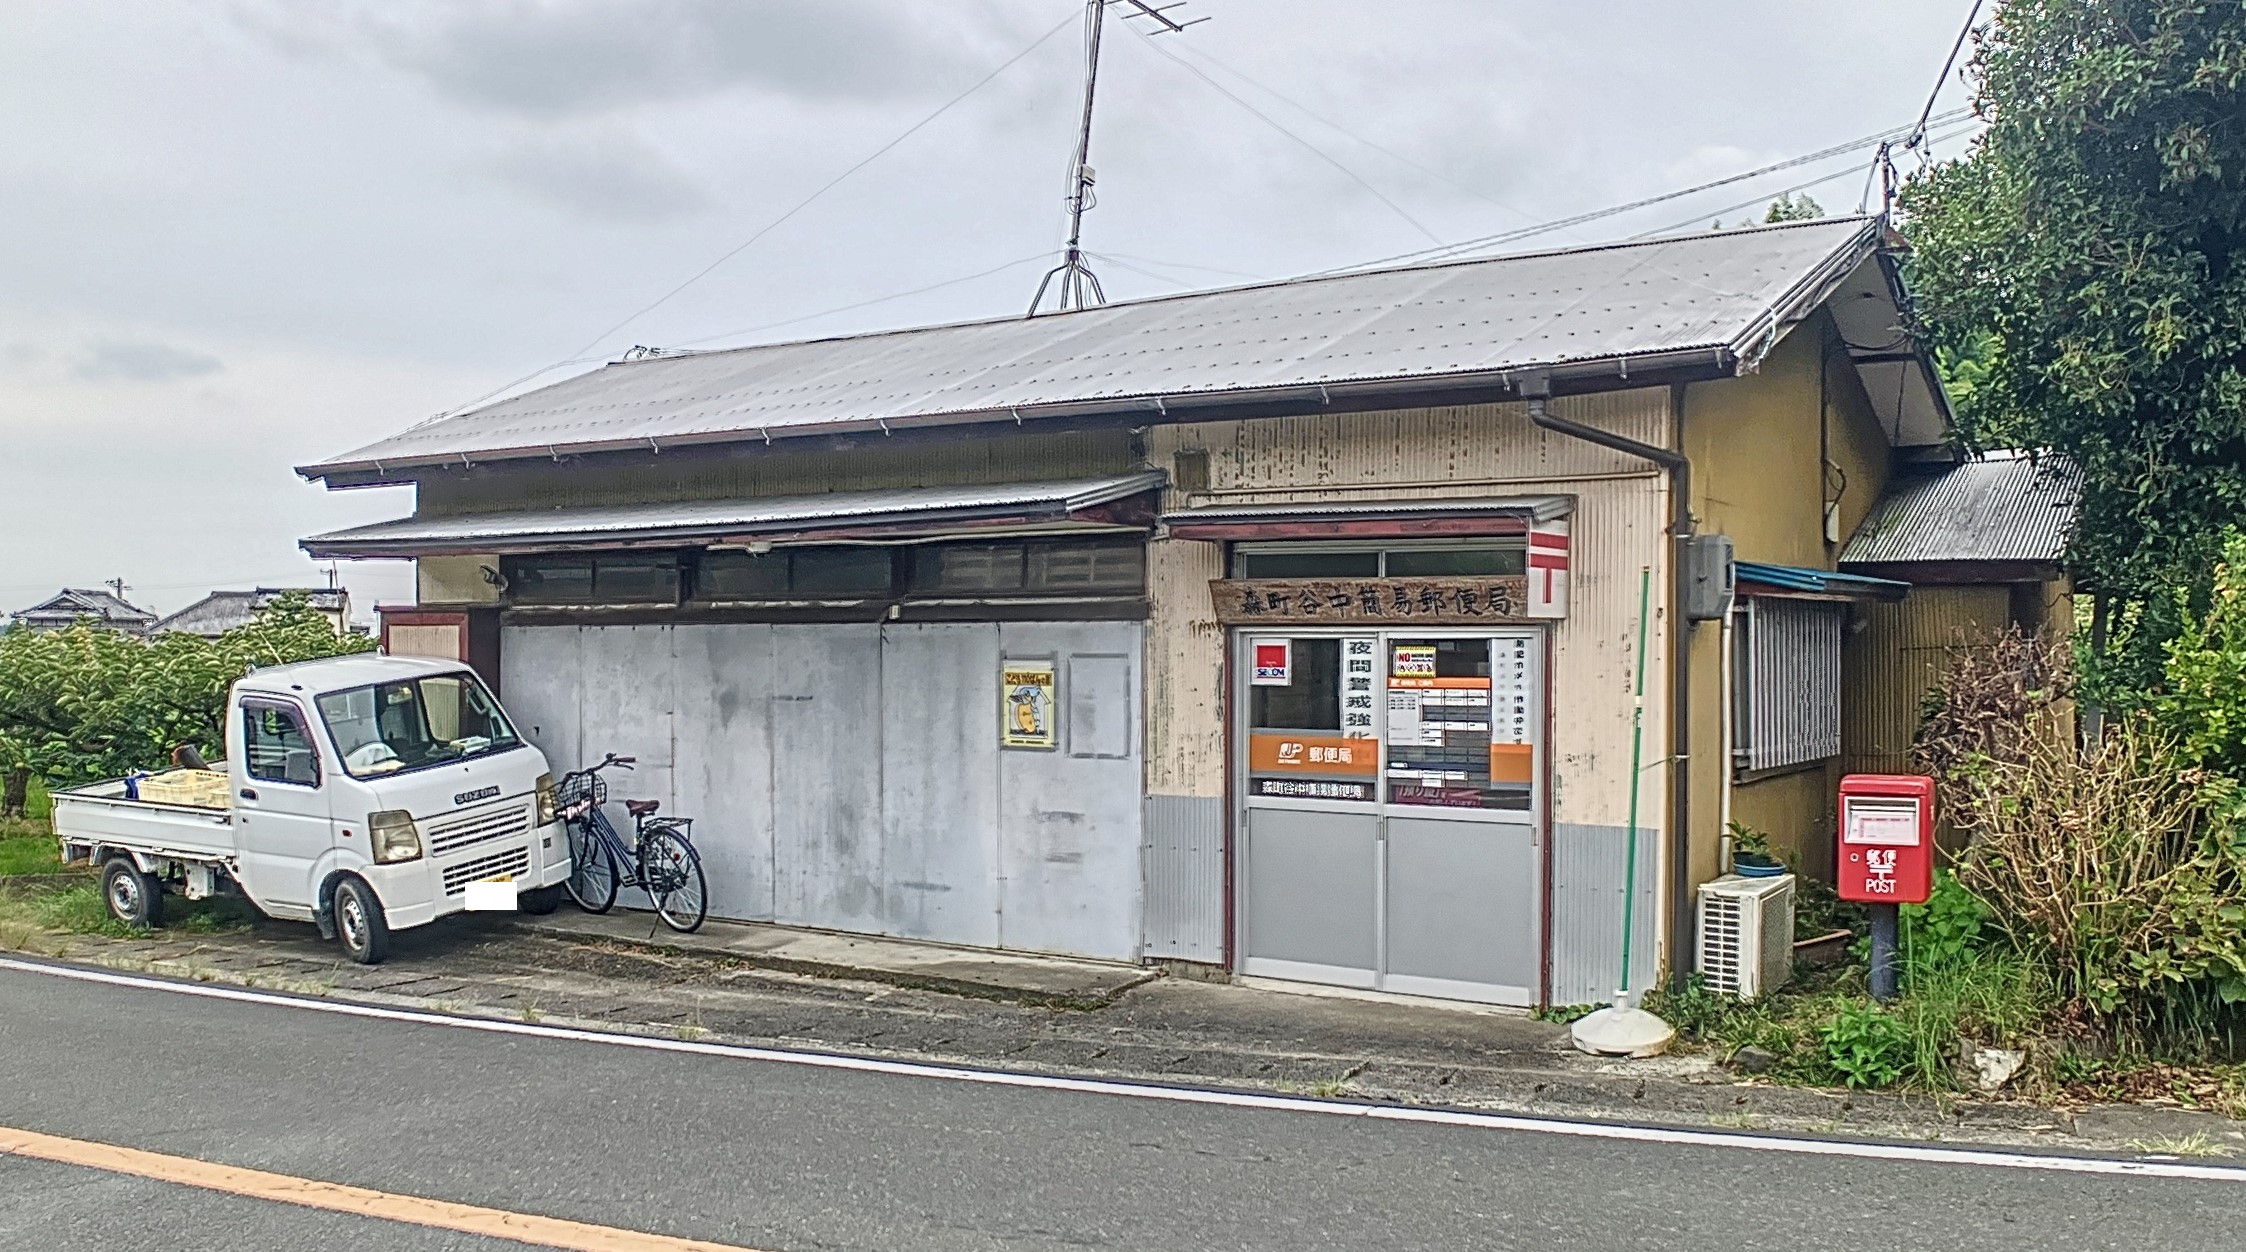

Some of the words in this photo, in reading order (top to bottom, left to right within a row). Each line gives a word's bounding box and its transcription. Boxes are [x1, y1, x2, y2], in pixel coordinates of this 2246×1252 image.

[1399, 652, 1411, 662] NO
[1309, 746, 1353, 764] 郵便局
[455, 785, 501, 804] SUZUKI
[1866, 849, 1897, 866] 郵便
[1865, 879, 1897, 894] POST
